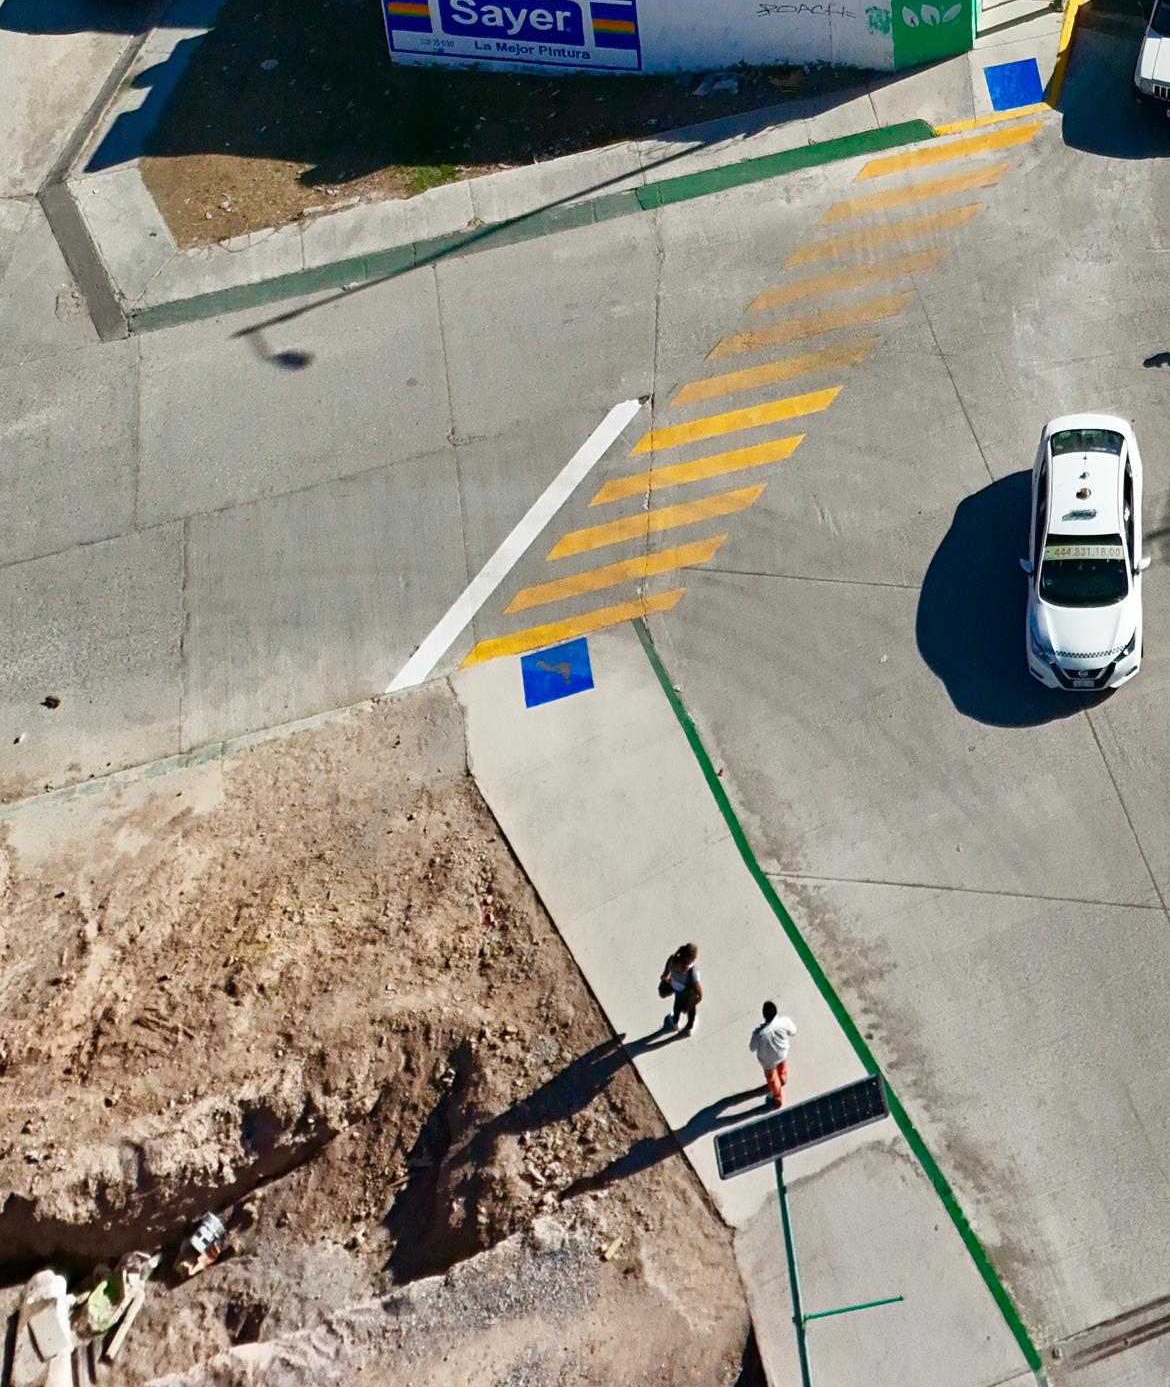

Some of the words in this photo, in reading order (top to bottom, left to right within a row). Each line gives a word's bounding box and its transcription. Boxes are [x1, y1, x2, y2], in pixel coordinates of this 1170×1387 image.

[474, 40, 492, 51] La
[496, 42, 535, 56] Mejor
[539, 45, 591, 60] Pintura
